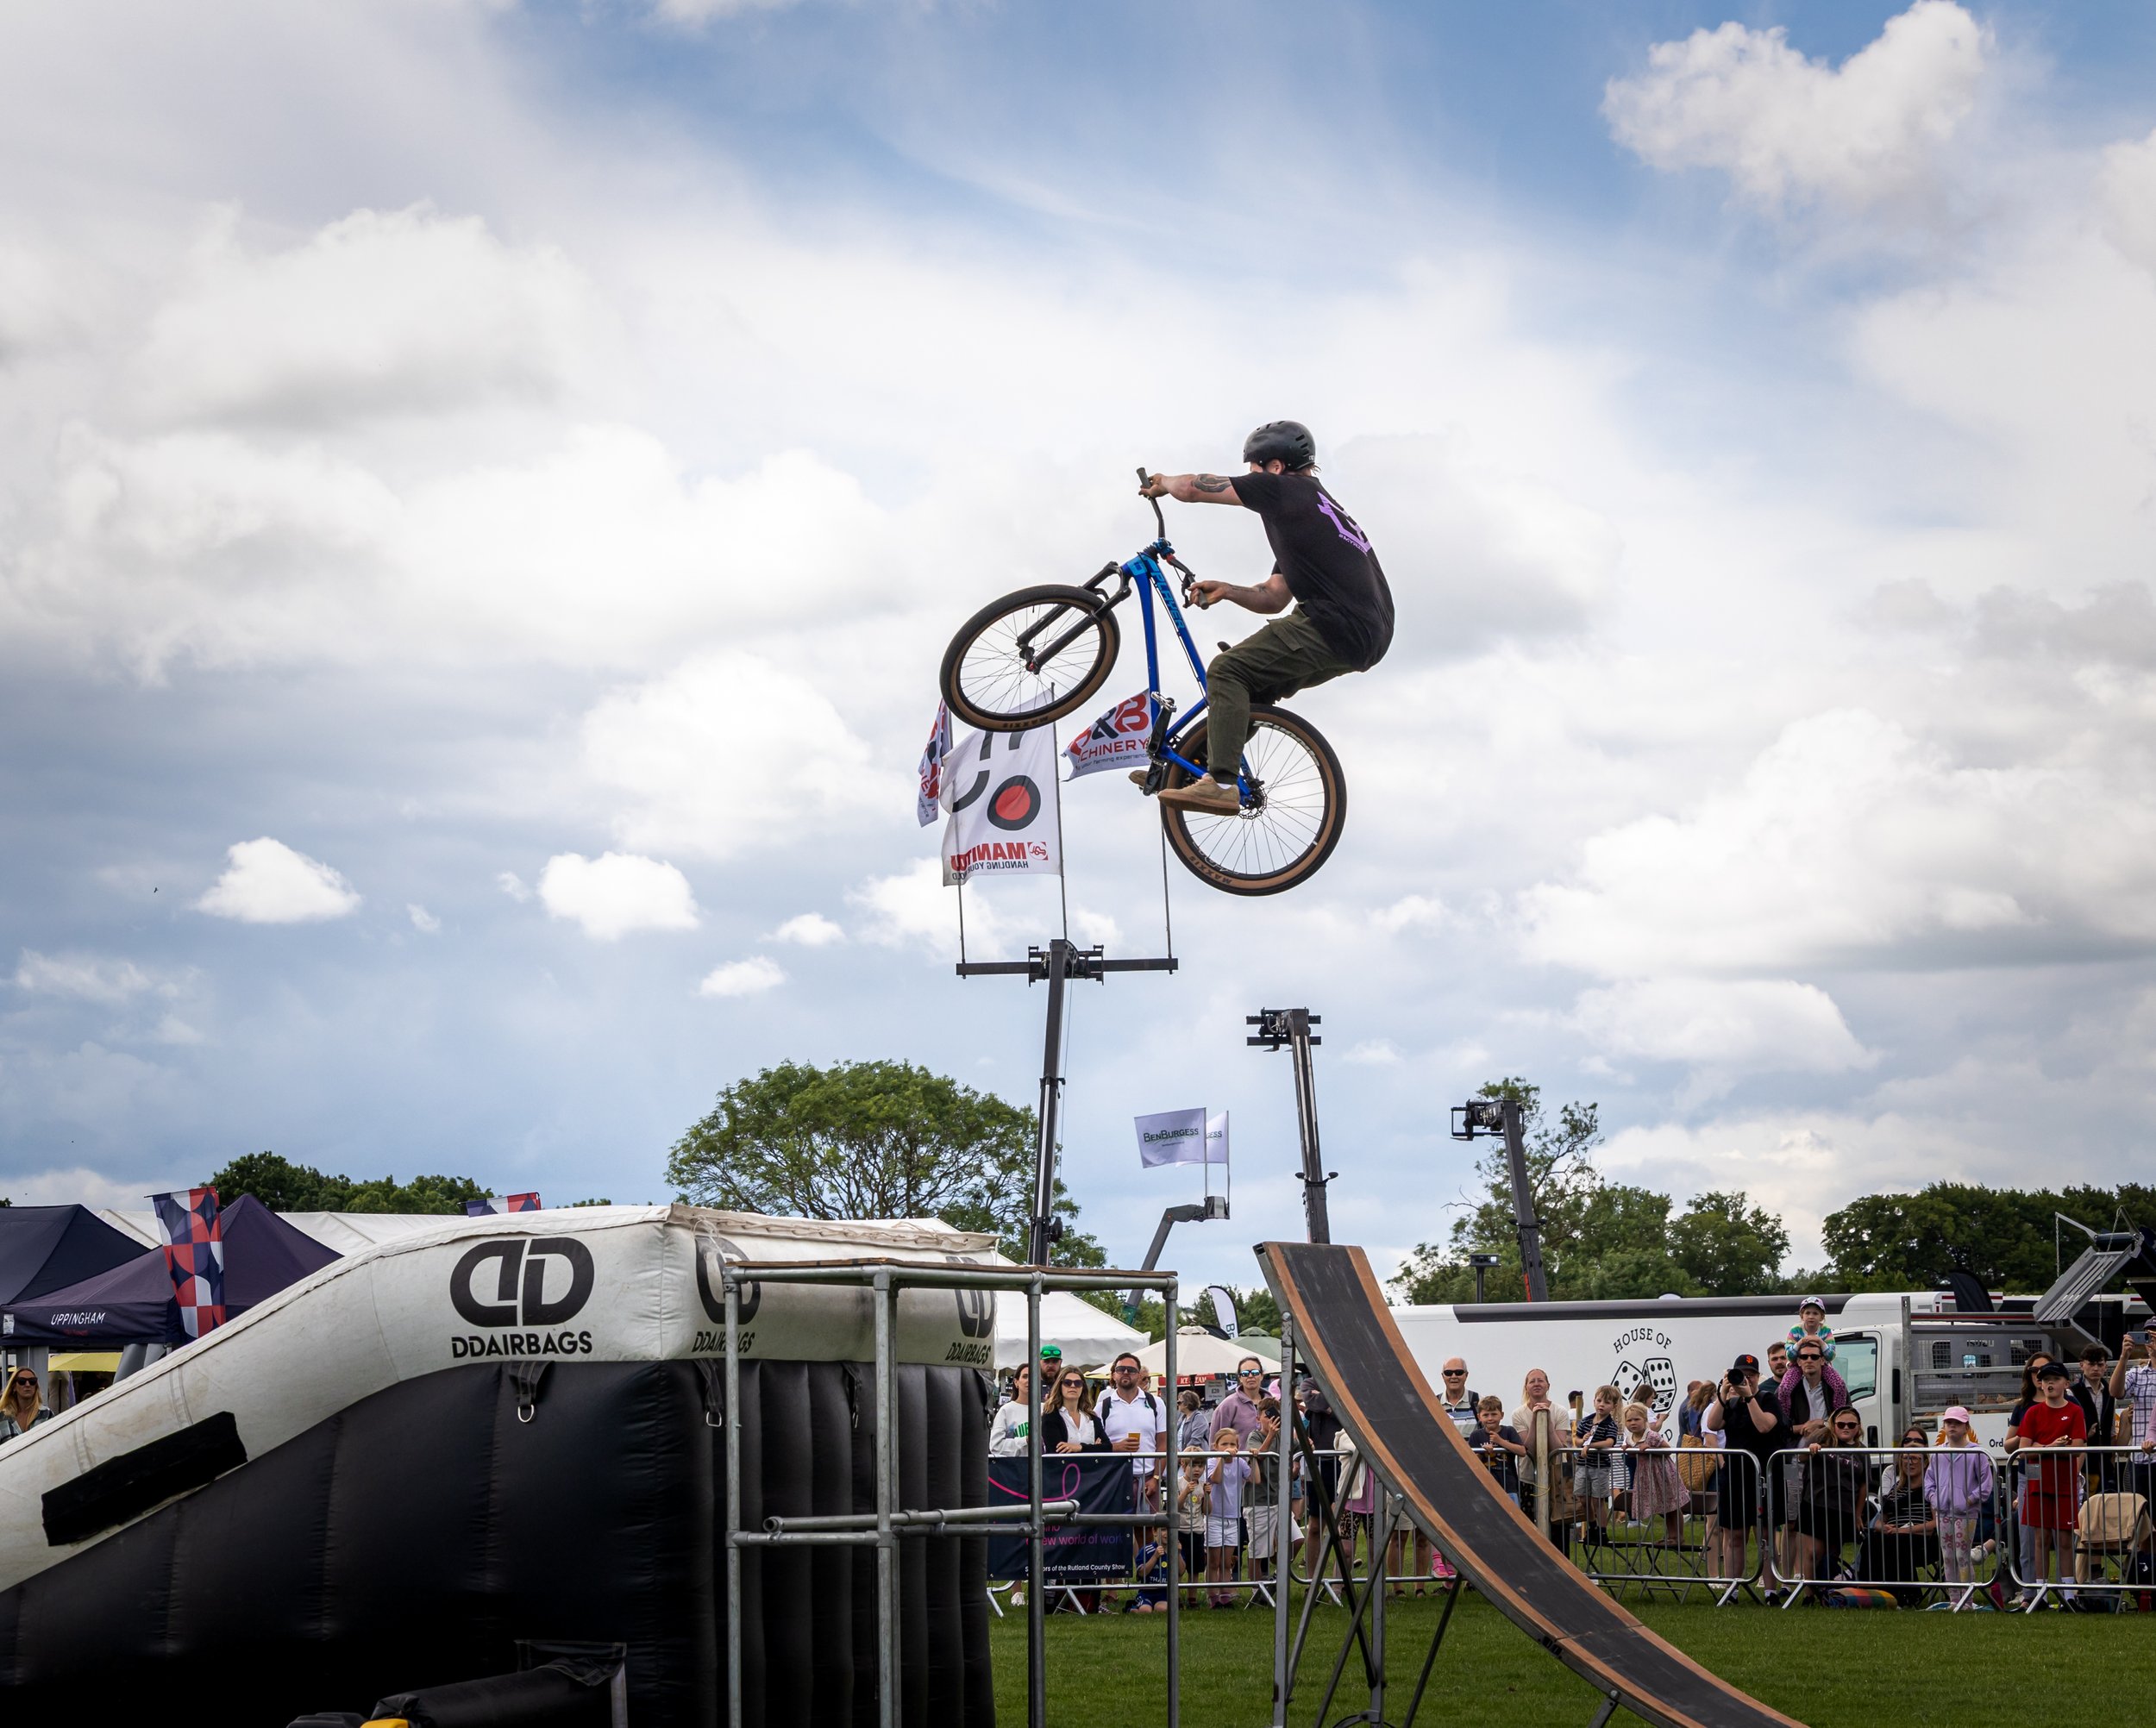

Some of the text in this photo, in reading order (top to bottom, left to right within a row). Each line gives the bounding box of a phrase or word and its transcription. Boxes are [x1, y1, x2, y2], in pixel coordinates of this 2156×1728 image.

[1078, 737, 1150, 763] CHINERY
[1189, 855, 1233, 885] MAXXIS
[51, 1312, 105, 1325] UPPINGHAM
[451, 1330, 593, 1359] DDAIRBAGS
[1613, 1328, 1671, 1354] HOUSE OF
[1966, 1338, 1995, 1348] ISUZU
[945, 1342, 992, 1365] DDAIRBAGS
[1989, 1437, 2004, 1448] Ord
[1058, 1534, 1087, 1545] world
[1087, 1533, 1099, 1544] of
[1090, 1563, 1111, 1573] County
